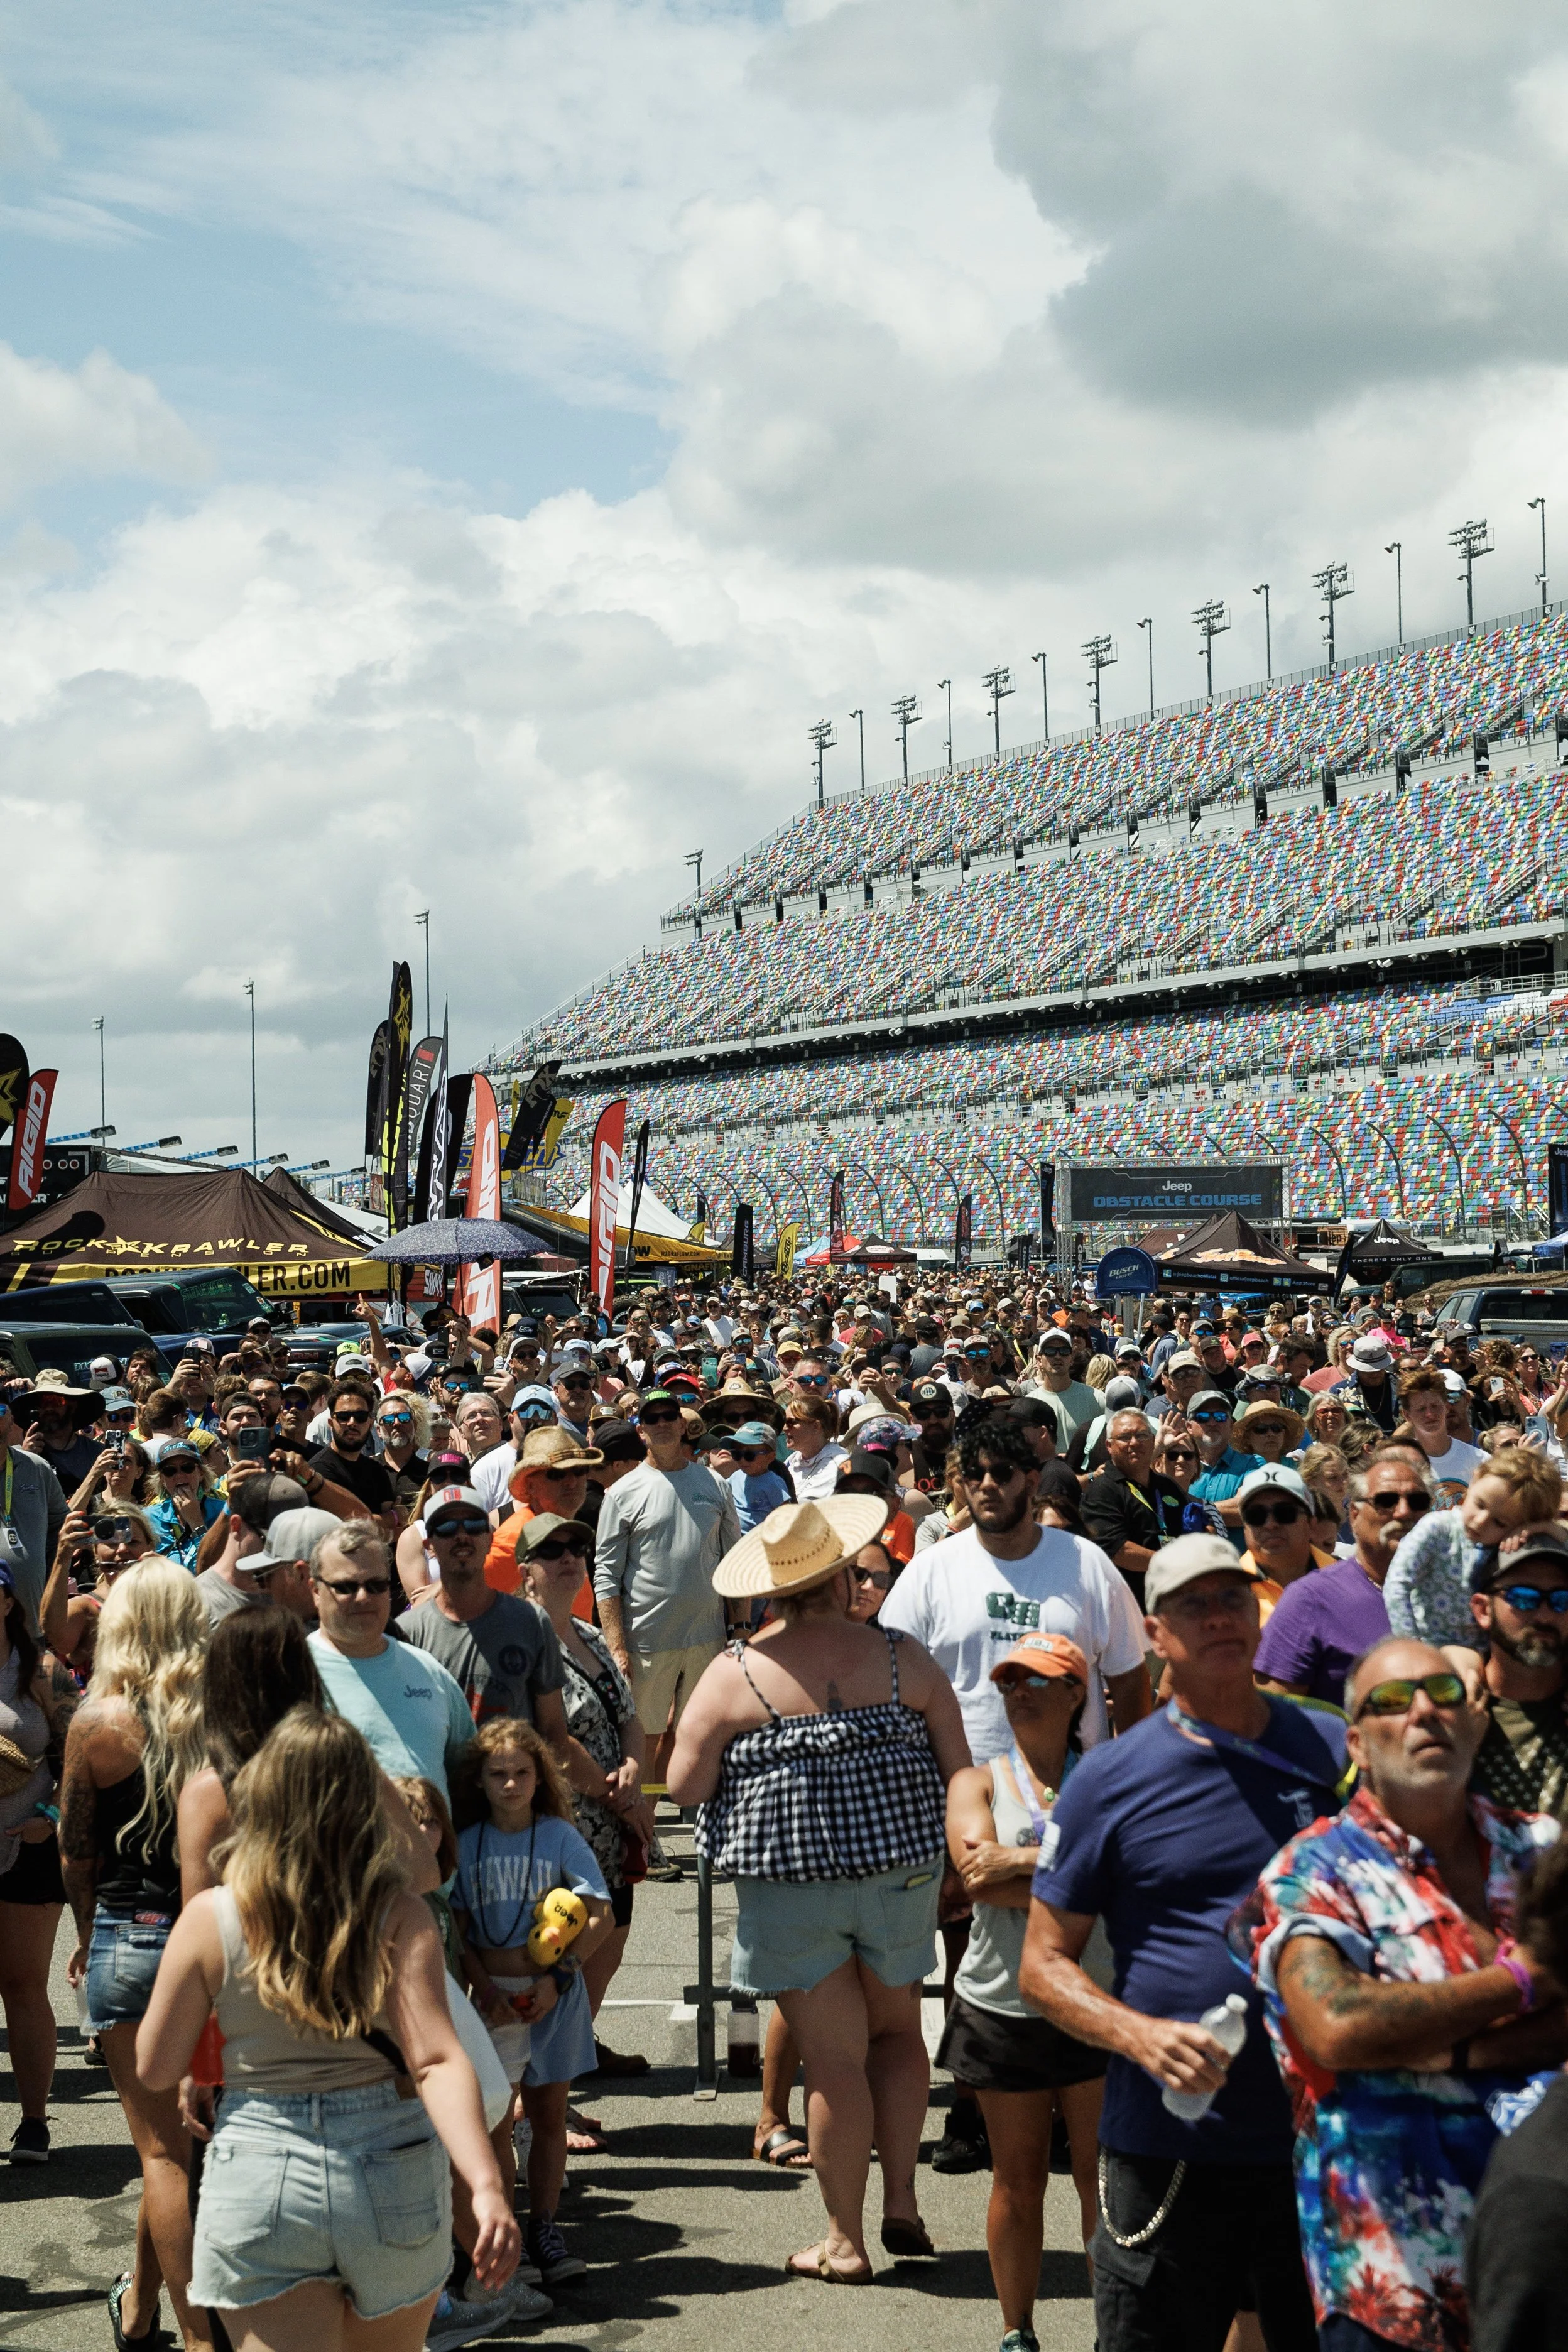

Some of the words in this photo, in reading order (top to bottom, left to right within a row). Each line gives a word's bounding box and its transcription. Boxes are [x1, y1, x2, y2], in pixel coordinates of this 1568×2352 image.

[409, 1059, 431, 1118] QUART
[18, 1081, 46, 1199] RIGID
[1162, 1180, 1192, 1192] Jeep
[1093, 1195, 1185, 1207] OBSTACLE
[1190, 1194, 1261, 1206] COURSE
[13, 1239, 107, 1251] ROCK
[142, 1238, 309, 1254] KRAWLER
[1373, 1236, 1400, 1244] Jeep
[1109, 1264, 1140, 1277] BUSCH
[403, 1684, 433, 1701] Jeep
[469, 1855, 553, 1909] HAWAII
[554, 1903, 578, 1927] Jeep
